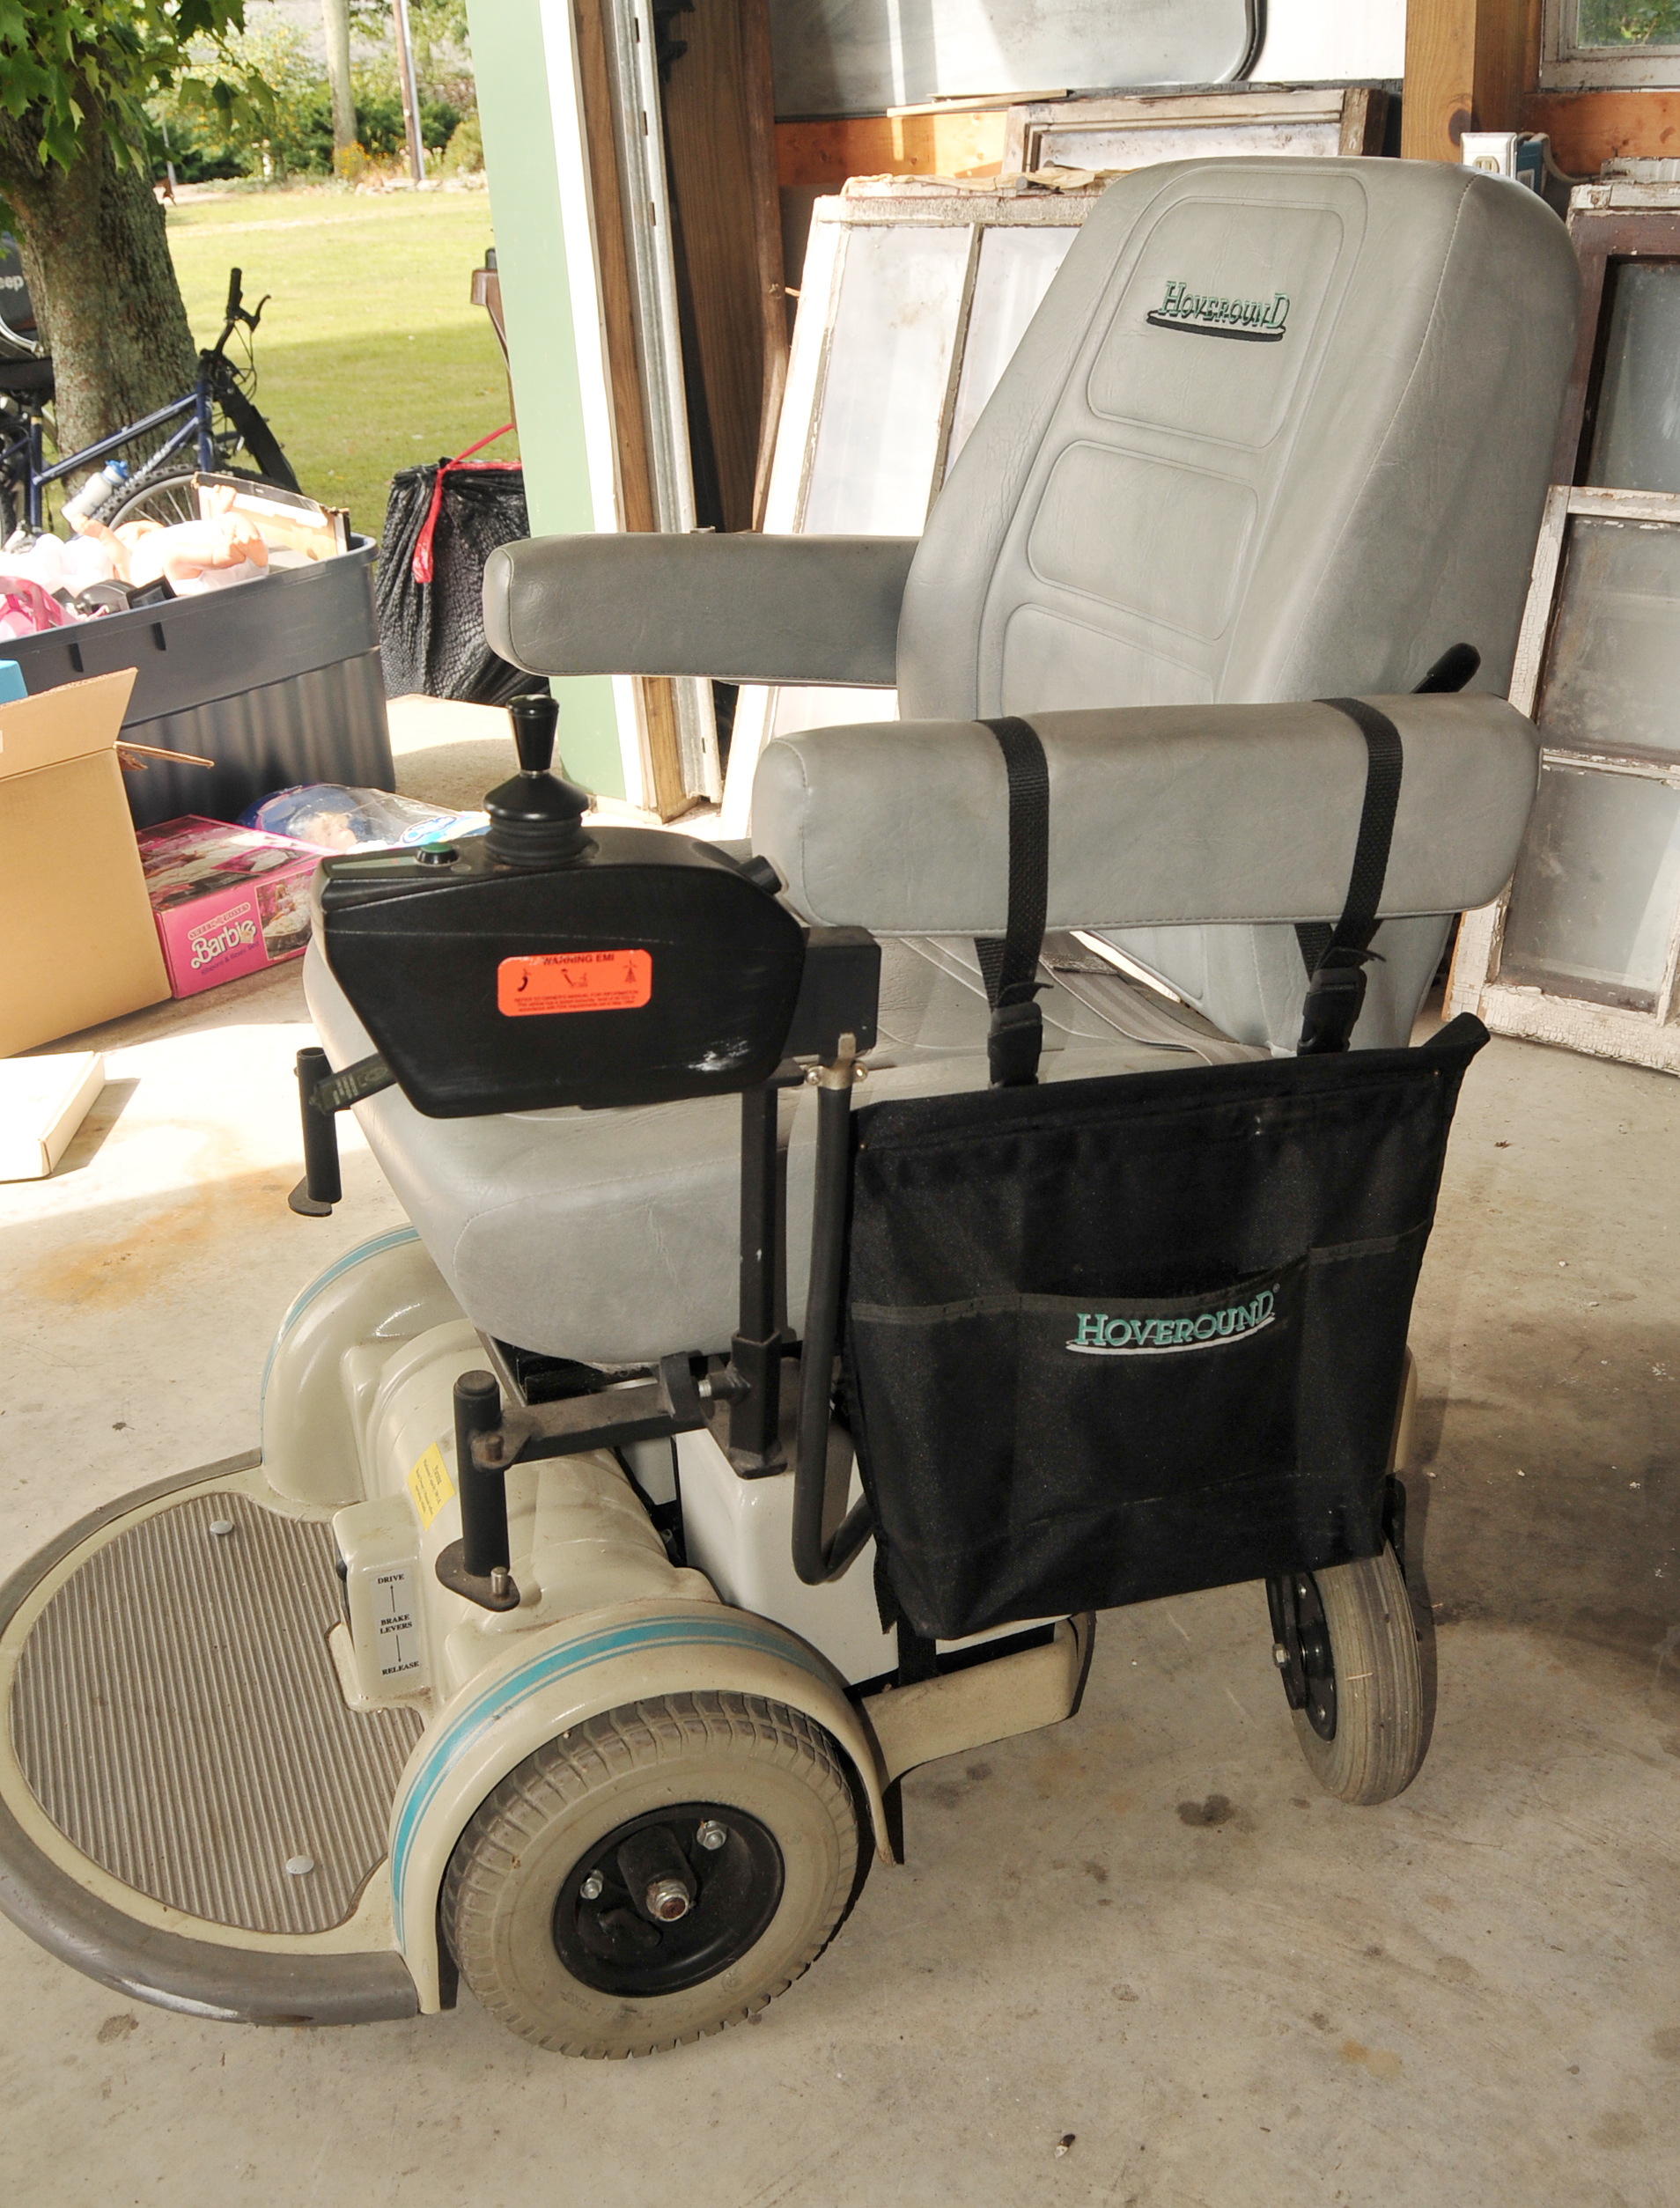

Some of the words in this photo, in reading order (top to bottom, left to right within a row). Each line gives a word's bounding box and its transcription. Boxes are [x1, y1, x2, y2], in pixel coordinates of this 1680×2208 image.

[1158, 281, 1290, 328] HOVEROUND
[191, 920, 256, 968] Barbie
[542, 953, 593, 966] WARNING
[596, 953, 615, 962] EMI
[1076, 1291, 1274, 1346] HOVEROUND
[378, 1573, 405, 1585] DRIVE
[380, 1614, 410, 1626] BRAKE
[379, 1621, 413, 1634] LEVERS
[381, 1660, 420, 1675] RELEASE
